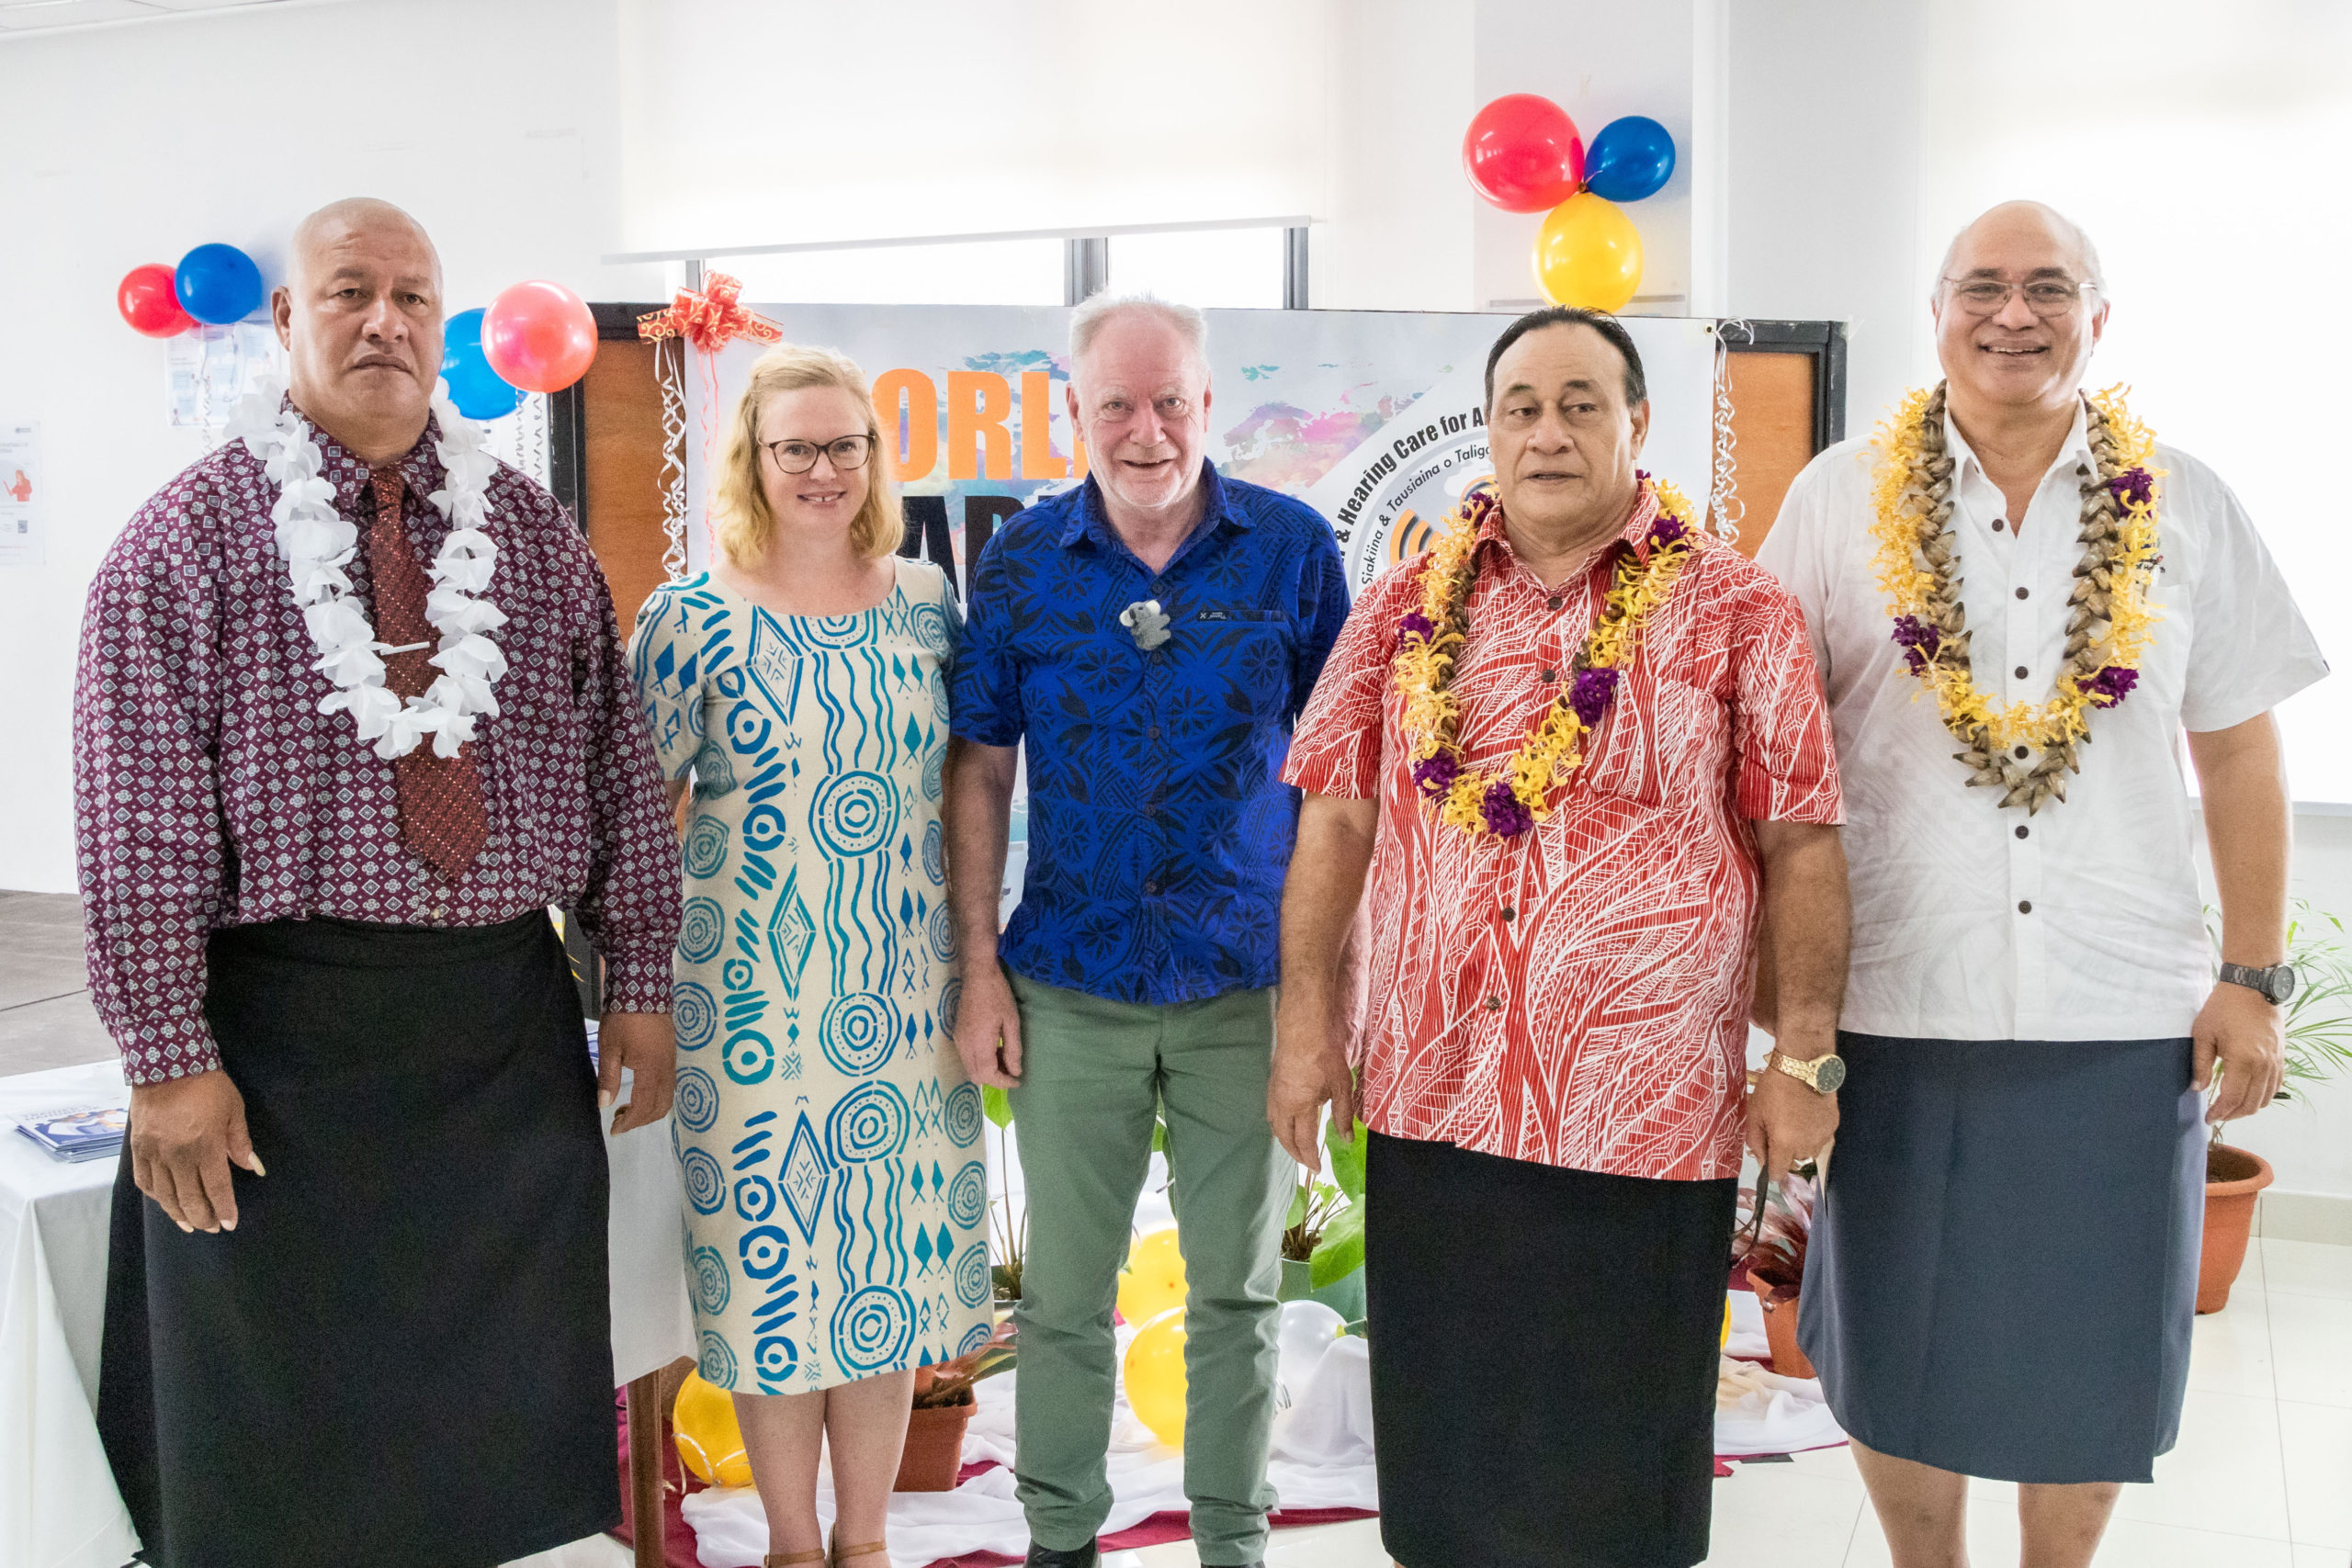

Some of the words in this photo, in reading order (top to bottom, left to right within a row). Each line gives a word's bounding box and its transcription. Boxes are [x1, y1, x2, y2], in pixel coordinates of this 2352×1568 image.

[871, 368, 1091, 482] ORL
[1440, 412, 1468, 436] for
[1472, 407, 1487, 428] A
[1393, 424, 1439, 460] Care
[1337, 452, 1397, 526] Hearing
[1335, 529, 1351, 544] &
[1362, 530, 1384, 585] Siakiina
[1378, 513, 1391, 527] &
[1386, 465, 1441, 513] Tausiaina
[1443, 459, 1453, 468] o
